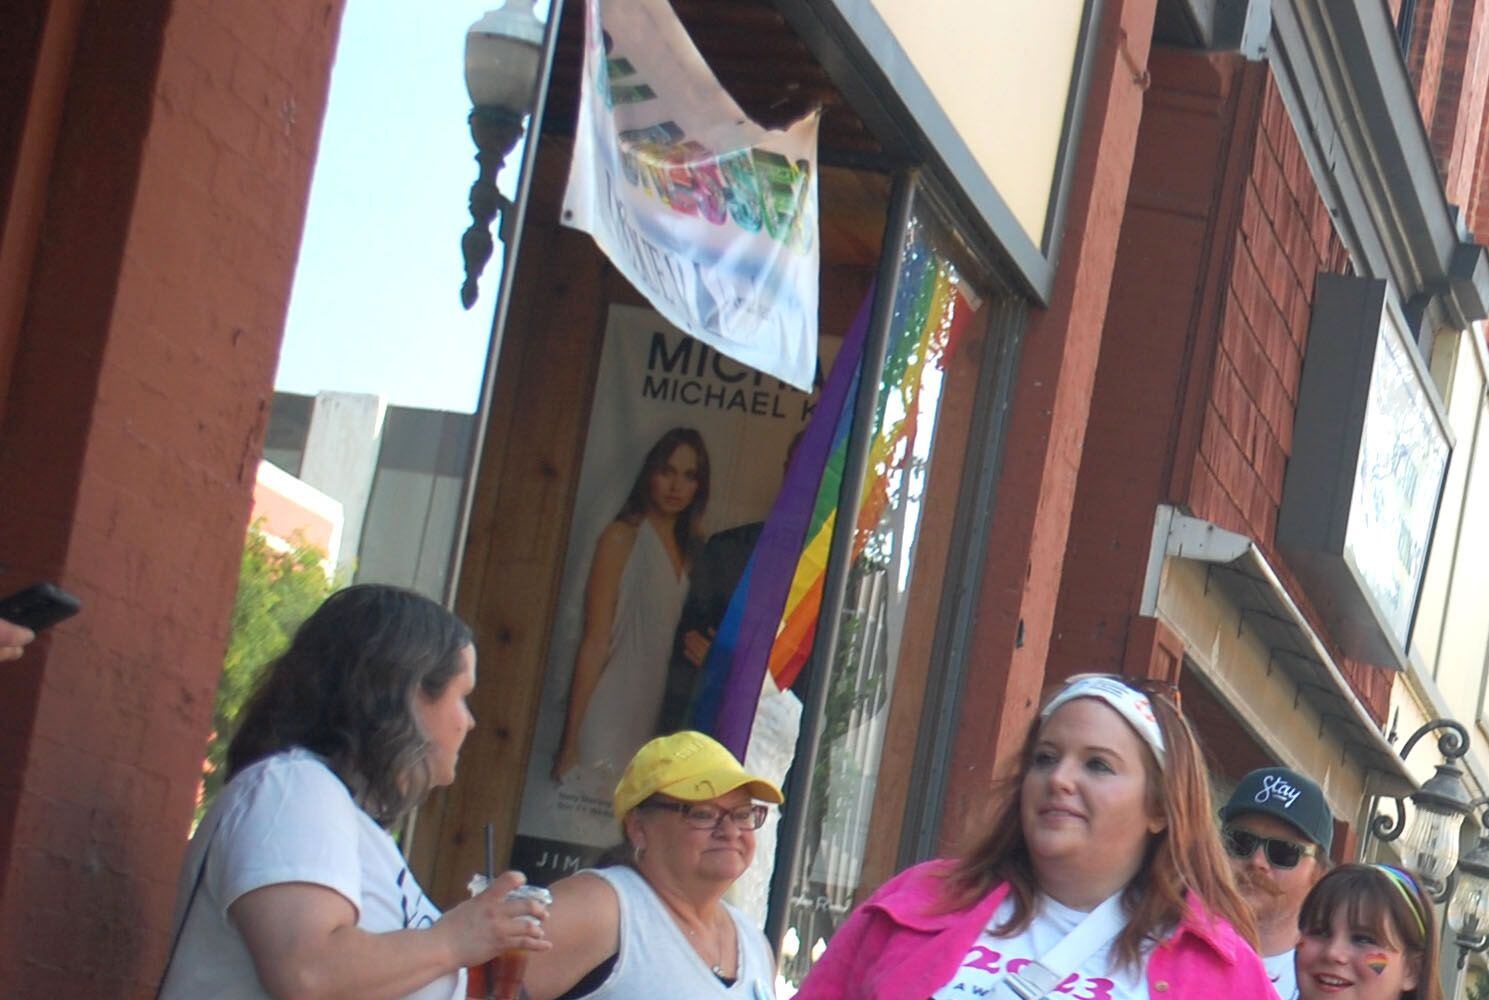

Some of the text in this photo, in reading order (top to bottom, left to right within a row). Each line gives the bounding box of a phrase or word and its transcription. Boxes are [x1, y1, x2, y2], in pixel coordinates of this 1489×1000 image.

[642, 375, 786, 420] MICHAEL
[1255, 775, 1302, 809] Stay
[536, 850, 581, 872] JIM
